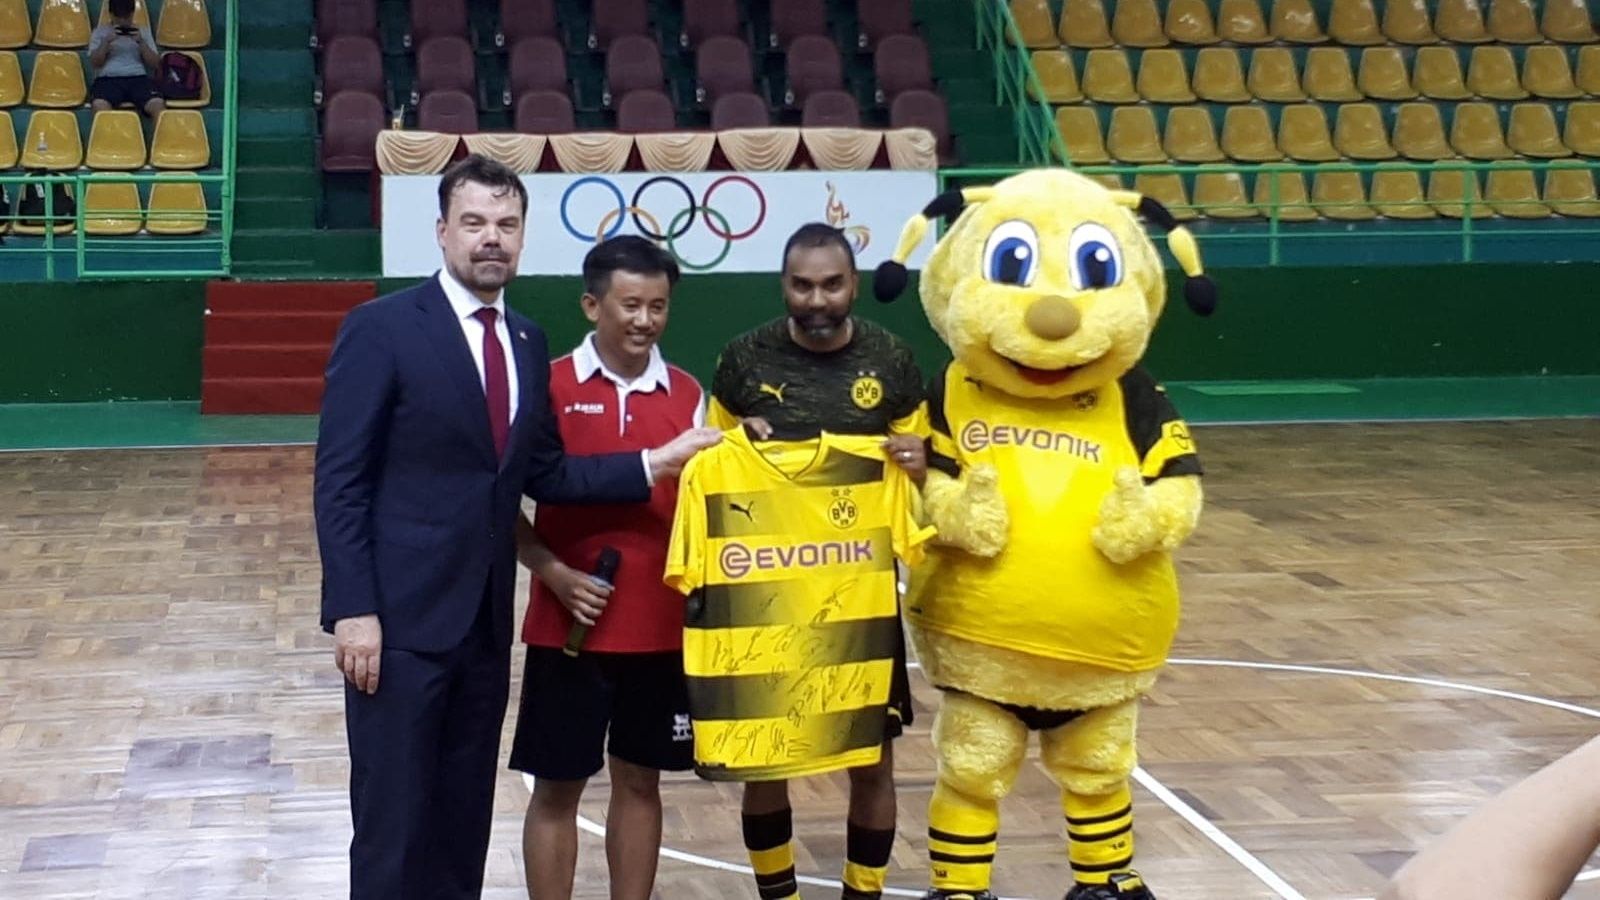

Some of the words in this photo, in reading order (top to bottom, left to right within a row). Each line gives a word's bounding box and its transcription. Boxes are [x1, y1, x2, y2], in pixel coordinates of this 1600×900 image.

[856, 381, 878, 399] BVB
[991, 425, 1100, 463] EVONIK
[832, 501, 855, 520] BVB
[756, 540, 872, 569] EVONIK
